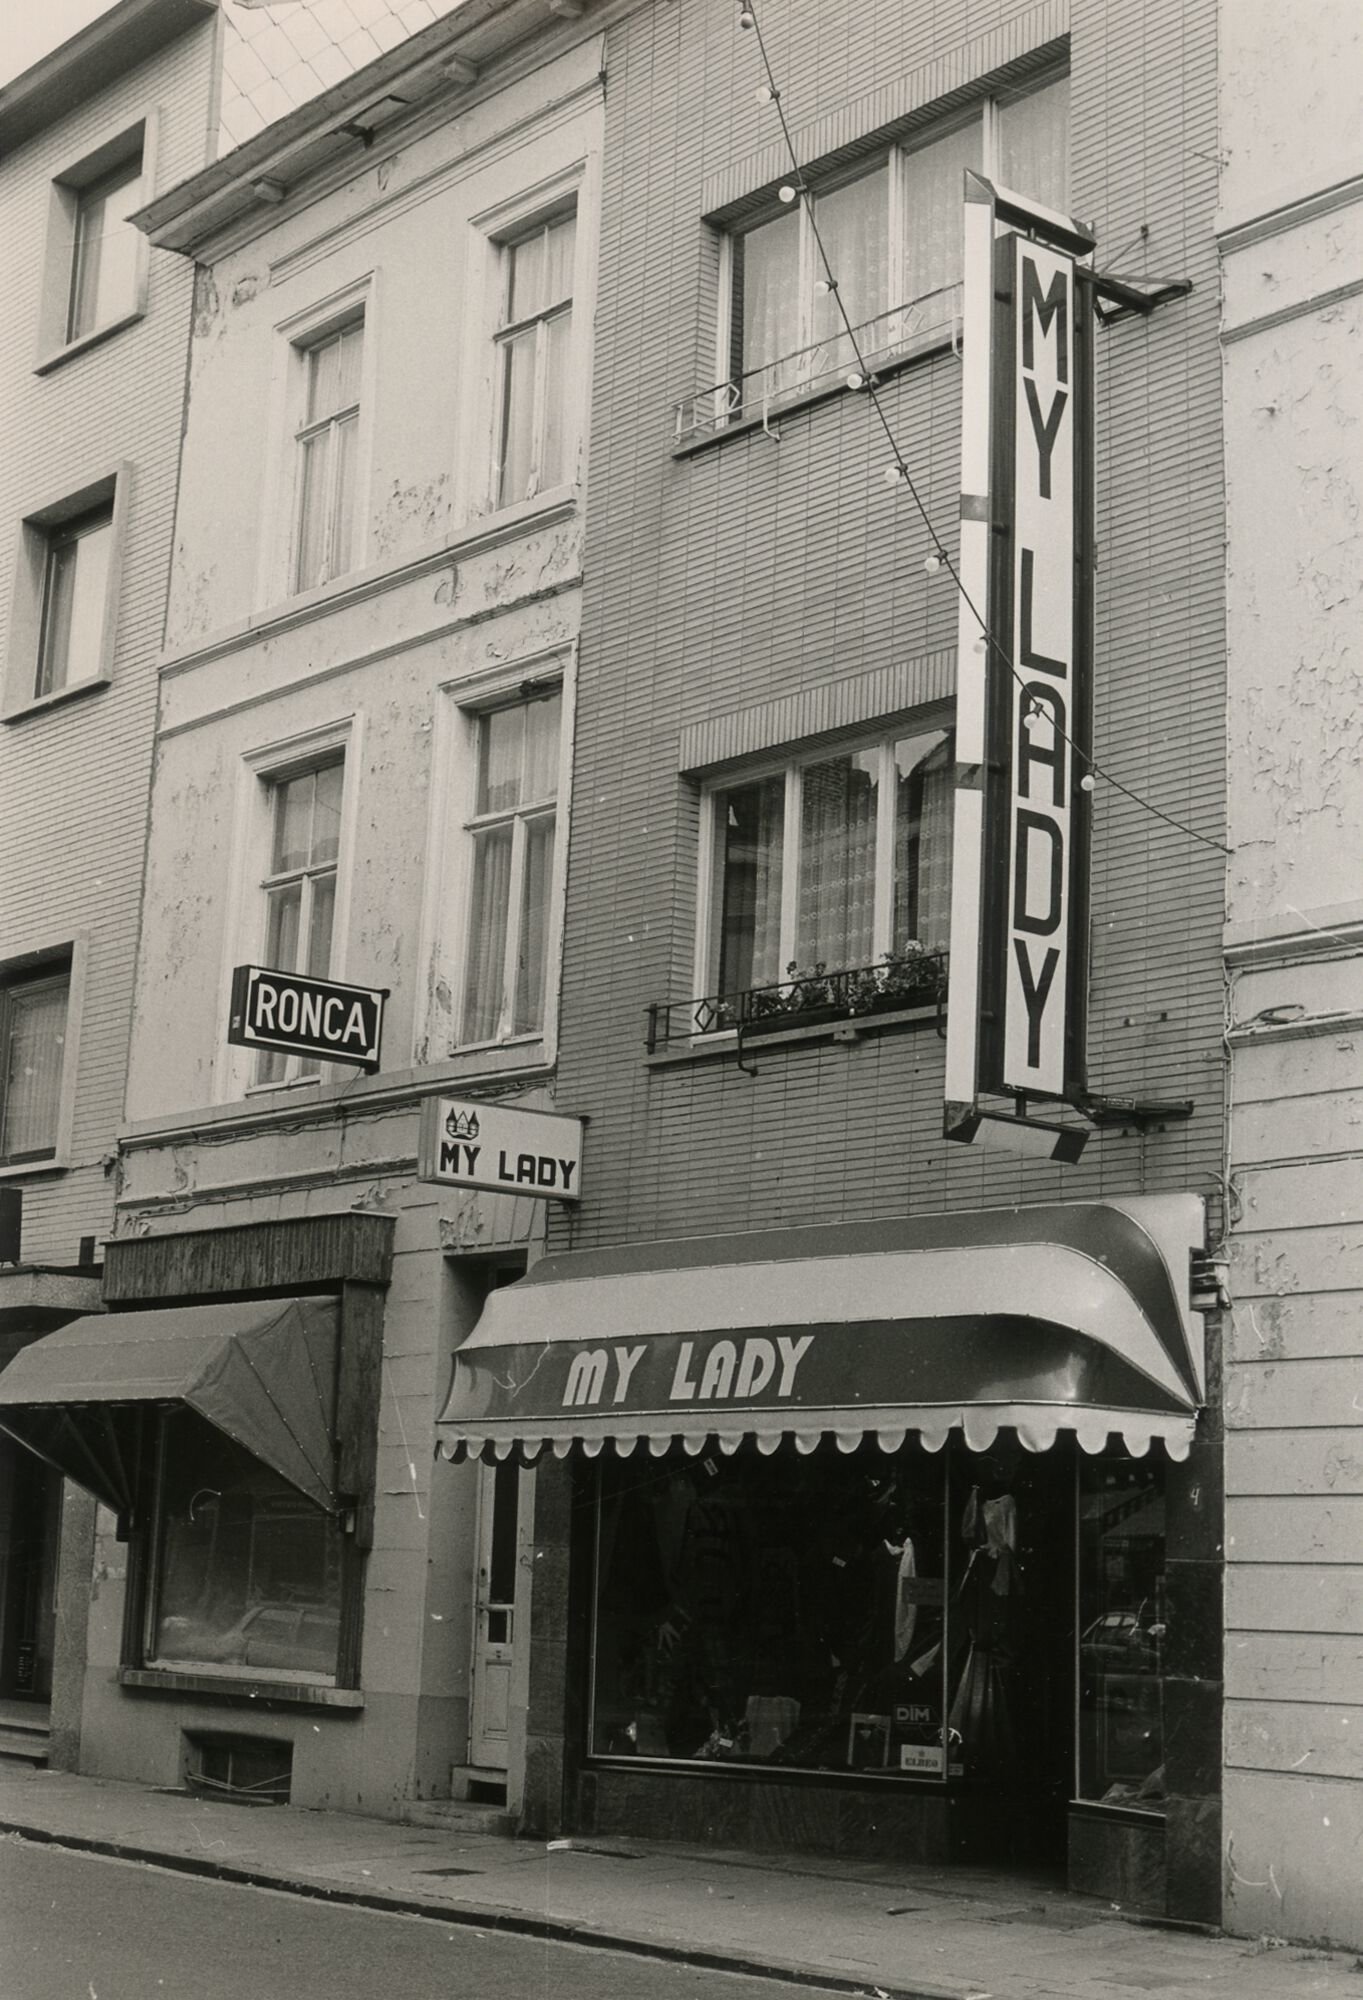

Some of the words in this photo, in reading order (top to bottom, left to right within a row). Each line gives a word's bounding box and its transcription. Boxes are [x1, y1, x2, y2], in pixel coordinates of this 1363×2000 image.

[1022, 255, 1069, 500] MY
[1013, 547, 1068, 1070] LADY
[255, 983, 368, 1047] RONCA
[440, 1142, 481, 1176] MY
[499, 1150, 577, 1190] LADY
[562, 1345, 648, 1407] MY
[669, 1335, 815, 1400] LADY
[896, 1706, 930, 1722] DIM
